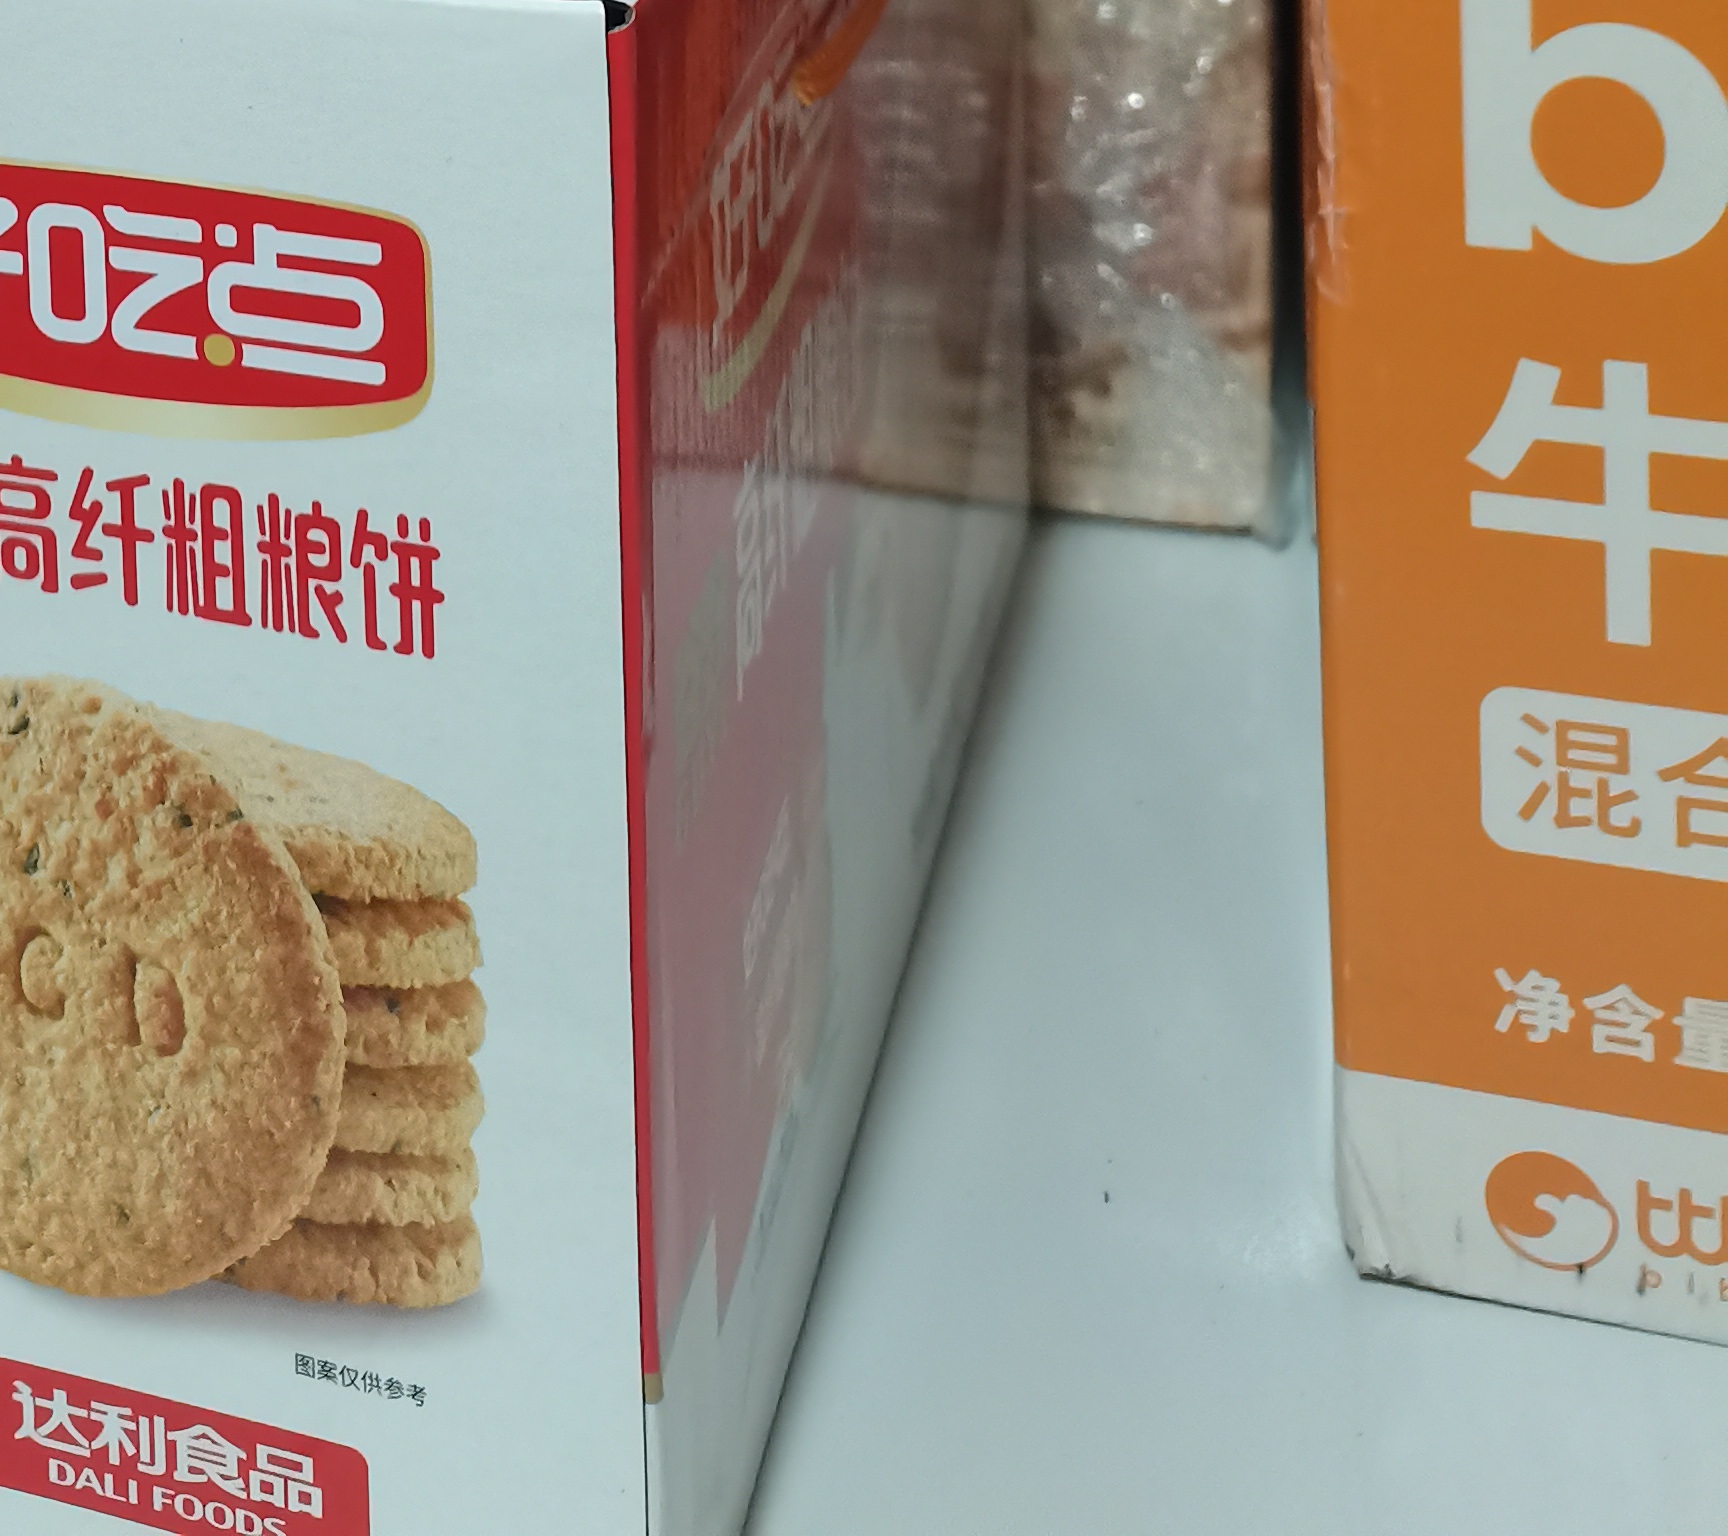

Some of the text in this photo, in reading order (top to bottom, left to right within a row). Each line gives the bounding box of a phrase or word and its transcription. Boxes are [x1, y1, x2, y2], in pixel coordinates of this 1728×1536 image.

[294, 1352, 428, 1408] 图案仅供参考
[11, 1379, 324, 1519] 达利食品
[48, 1457, 287, 1536] DALI FOODS
